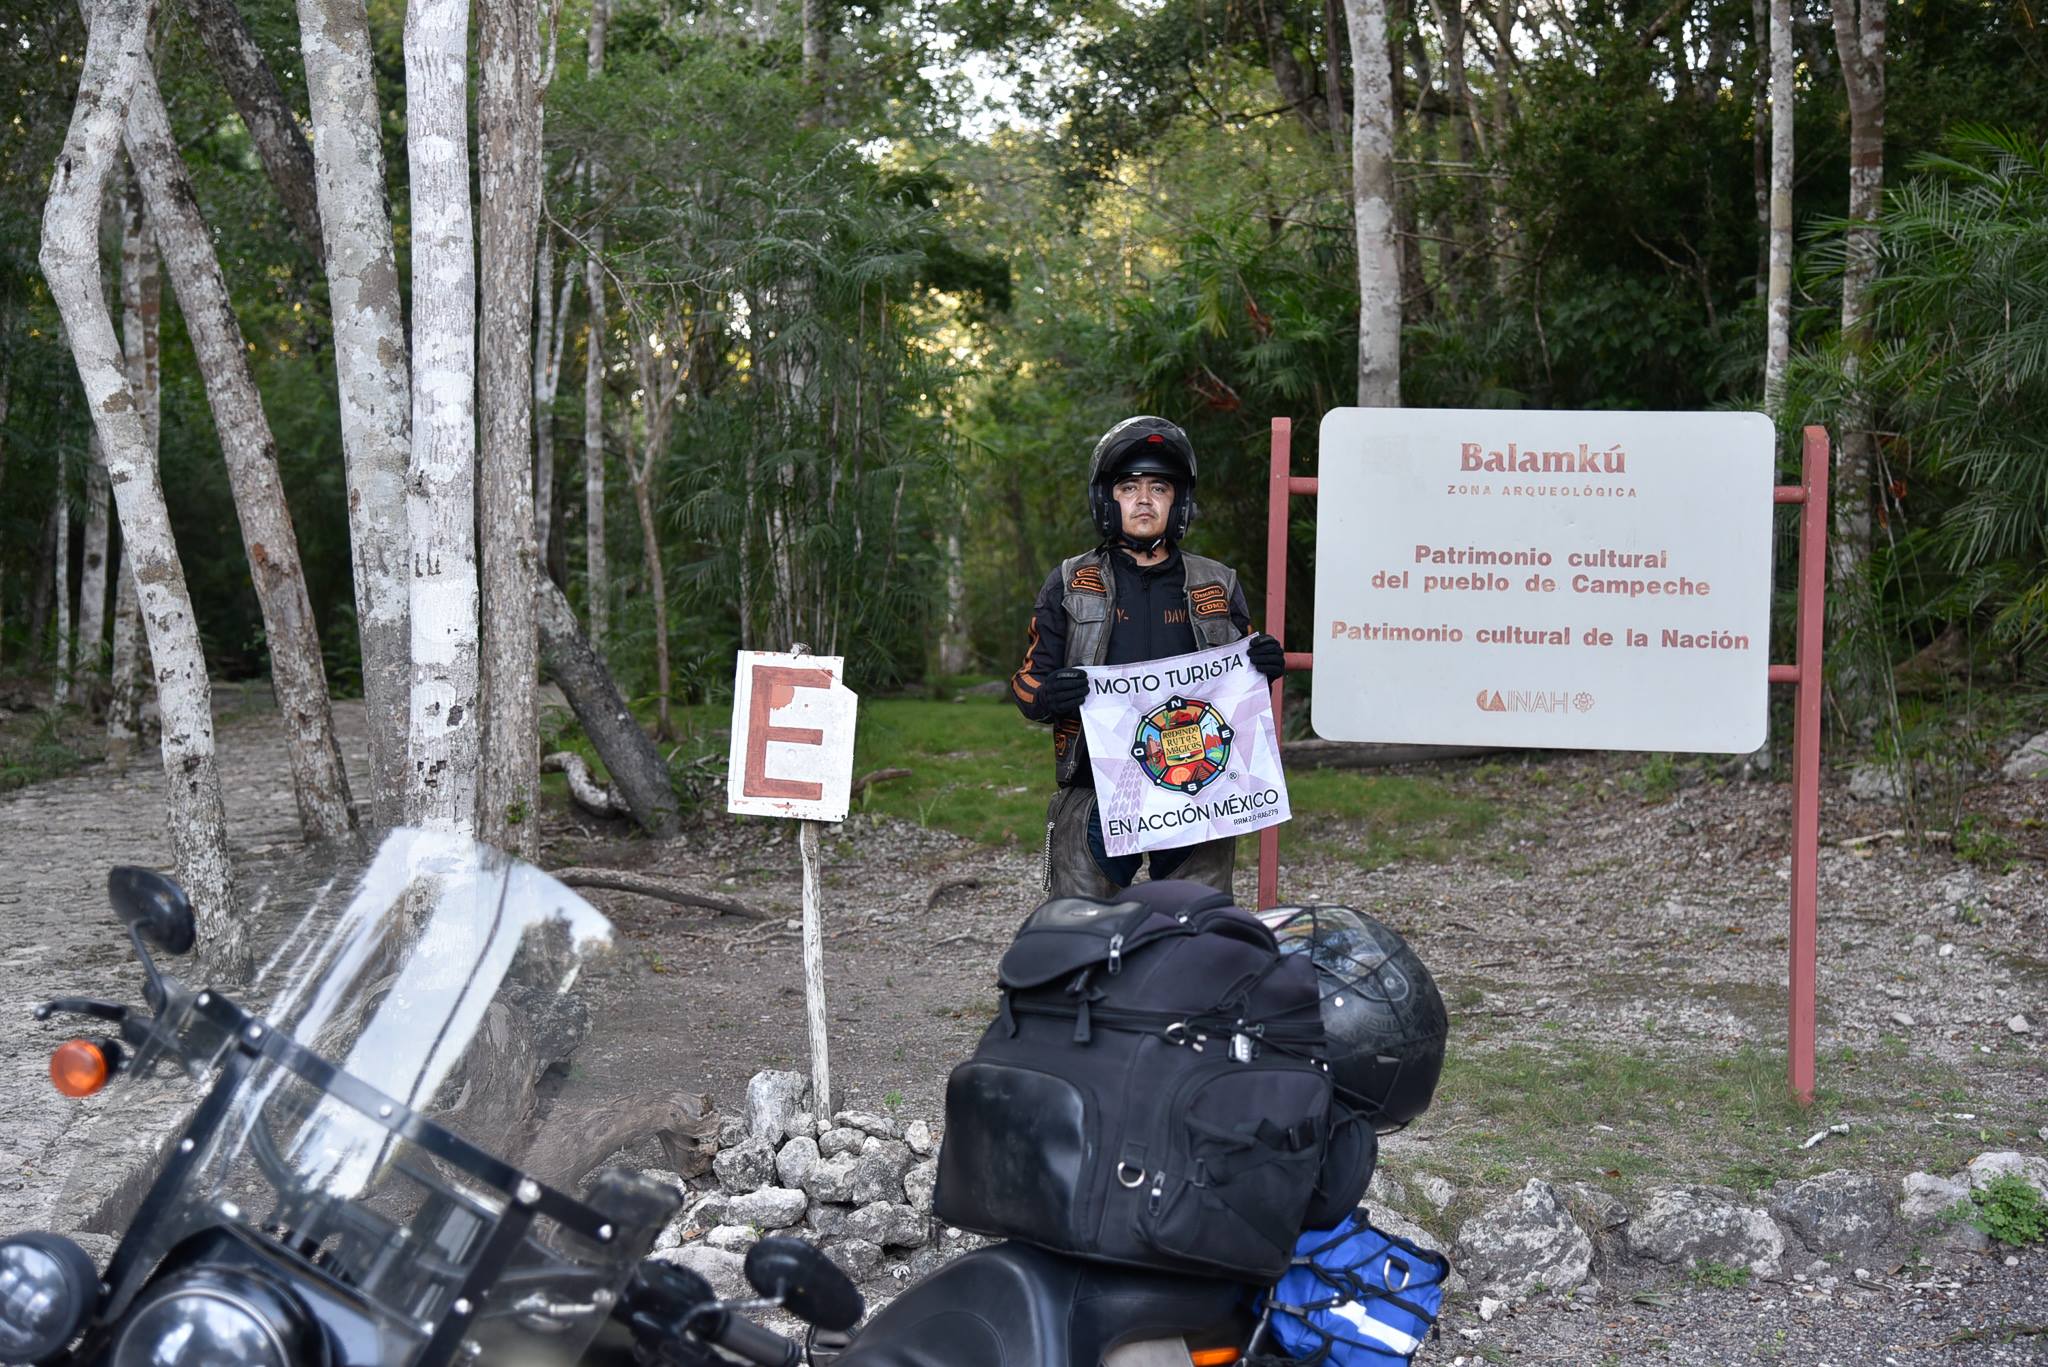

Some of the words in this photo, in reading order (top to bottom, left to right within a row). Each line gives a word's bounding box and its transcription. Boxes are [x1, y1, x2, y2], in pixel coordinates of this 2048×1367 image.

[1460, 441, 1627, 475] Balamkú
[1447, 484, 1493, 496] ZONA
[1502, 485, 1638, 498] ARQUEOLÓGICA
[1414, 544, 1553, 568] Patrimonio
[1567, 549, 1669, 569] cultural
[1371, 570, 1410, 590] del
[1423, 571, 1511, 594] pueblo
[1524, 574, 1557, 593] de
[1571, 574, 1711, 598] Campeche
[1331, 620, 1464, 642] Patrimonio
[1475, 625, 1571, 646] cultural
[1583, 627, 1613, 647] de
[1625, 627, 1649, 648] la
[1662, 628, 1750, 650] Nación
[1094, 674, 1161, 695] MOTO
[1165, 653, 1244, 688] TURISTA
[1171, 700, 1182, 709] N
[743, 664, 833, 800] E
[1221, 729, 1231, 738] E
[1133, 748, 1145, 756] O
[1187, 783, 1197, 791] S
[1108, 818, 1133, 836] EN
[1137, 802, 1210, 833] ACCIÓN
[1213, 789, 1279, 818] MÉXICO
